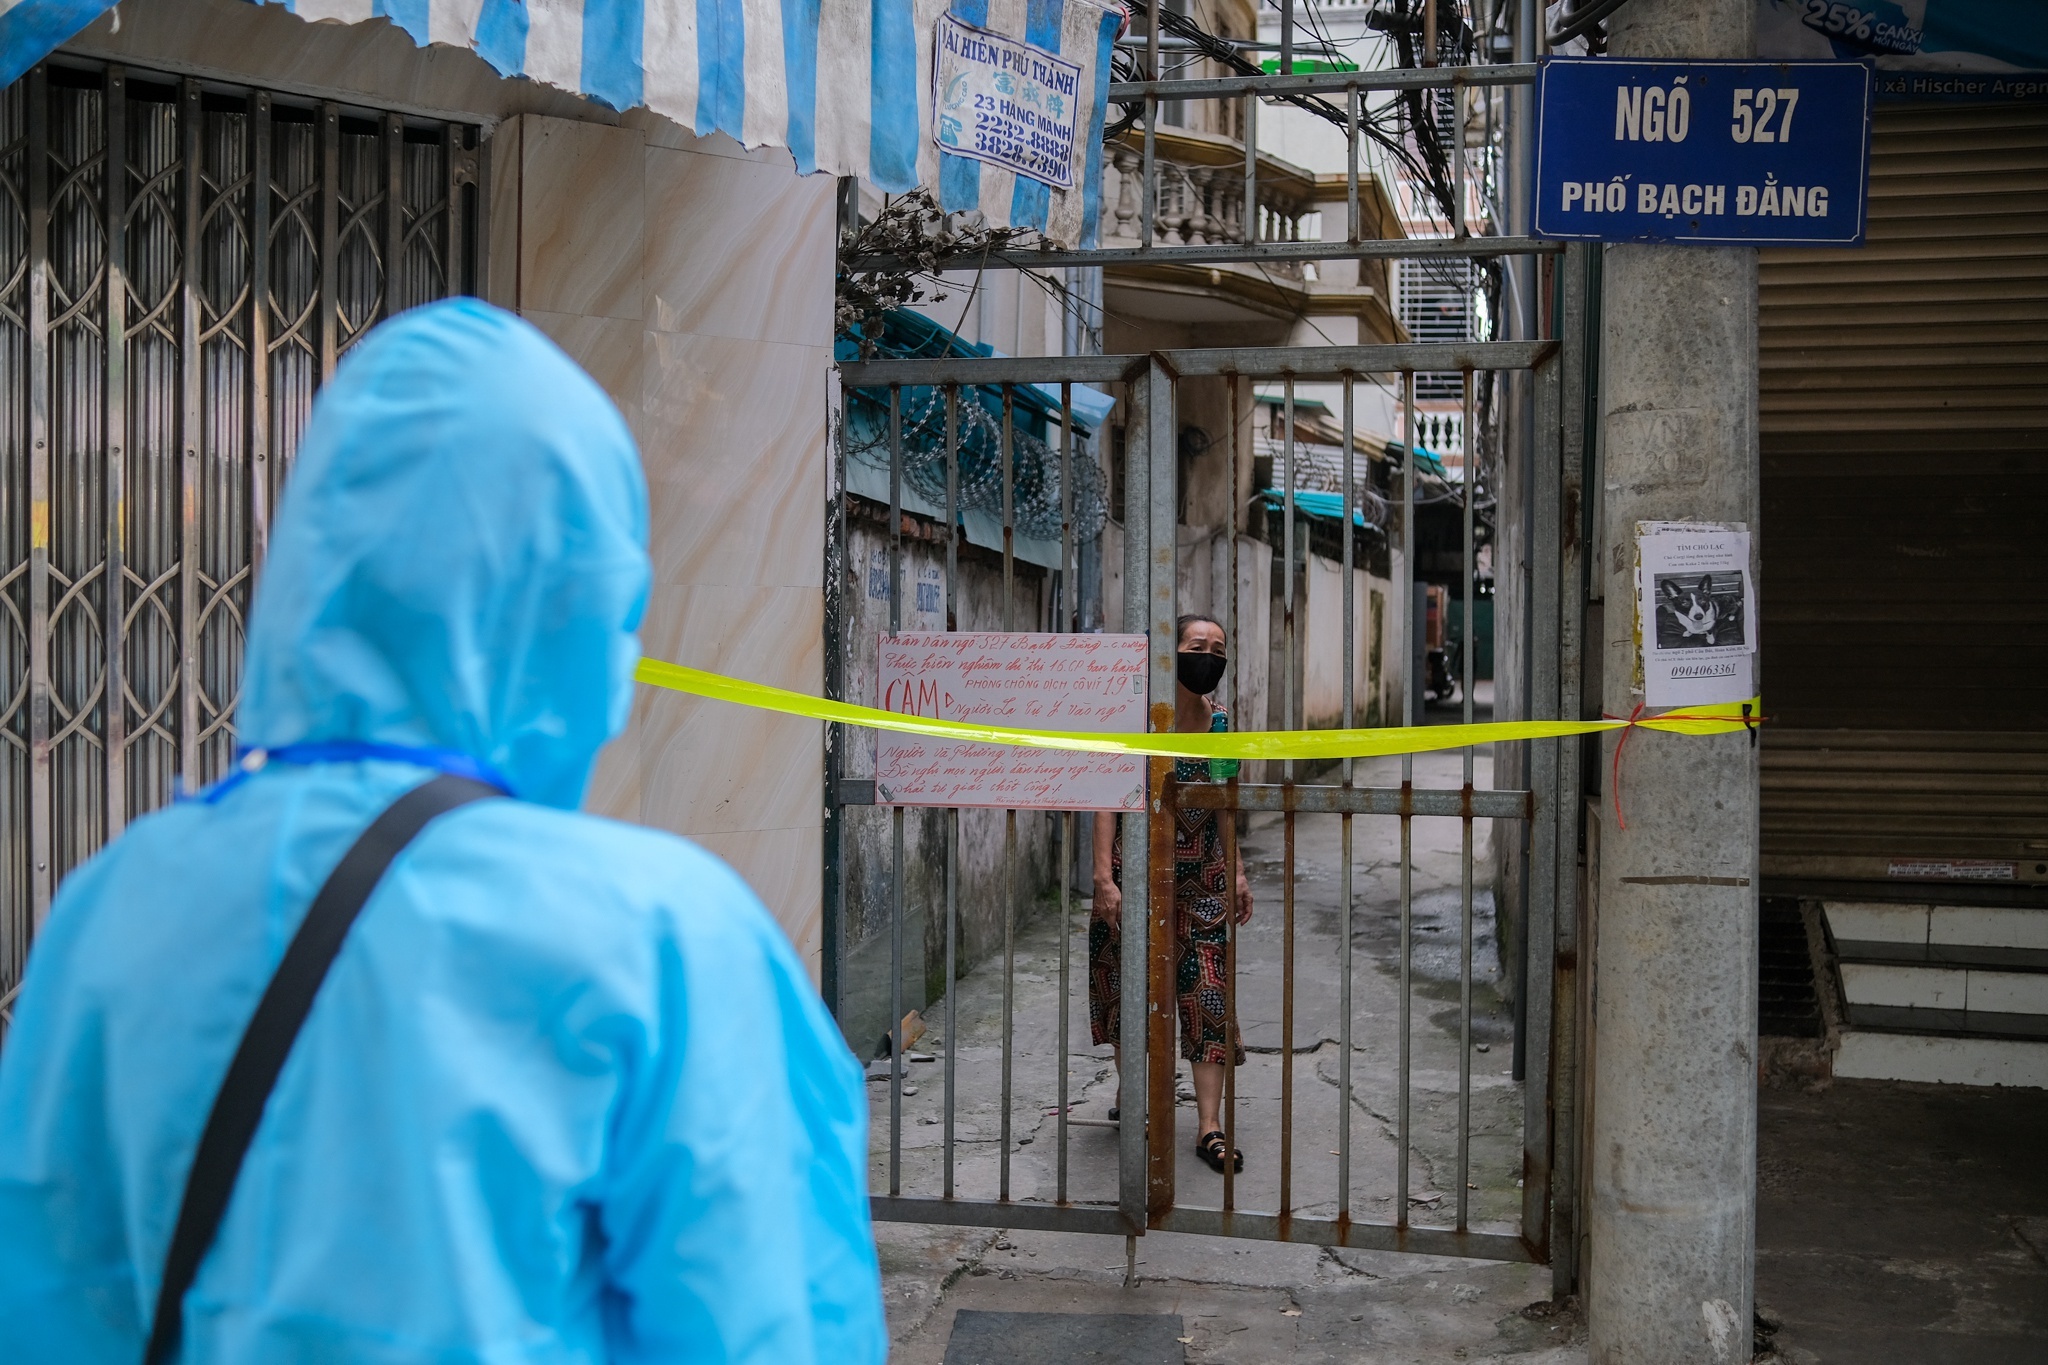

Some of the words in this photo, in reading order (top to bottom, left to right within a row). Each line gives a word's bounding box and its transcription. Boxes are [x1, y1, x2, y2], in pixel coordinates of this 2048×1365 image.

[1804, 0, 1874, 39] 25%
[1876, 22, 1924, 44] CANXI
[960, 36, 1000, 67] HIÊN
[1913, 78, 1985, 94] Hischer
[974, 93, 996, 111] 23
[999, 98, 1035, 127] HÀNG
[1037, 114, 1071, 142] MÀNH
[1615, 75, 1690, 143] NGÕ
[1731, 88, 1799, 143] 527
[975, 112, 1069, 162] 2232.8888
[975, 132, 1067, 181] 3828.7390
[1562, 173, 1632, 213] PHỐ
[1637, 183, 1725, 219] BẠCH
[1736, 172, 1828, 217] ĐẰNG
[1677, 543, 1691, 551] TÌM
[1692, 542, 1708, 551] CHÓ
[979, 635, 1010, 650] 527
[964, 675, 1002, 689] PHÒNG
[1004, 673, 1039, 689] CHỐNG
[1043, 678, 1067, 692] DỊCH
[1103, 674, 1129, 696] 19
[1671, 663, 1736, 677] 0904063361
[885, 668, 939, 720] CẤM
